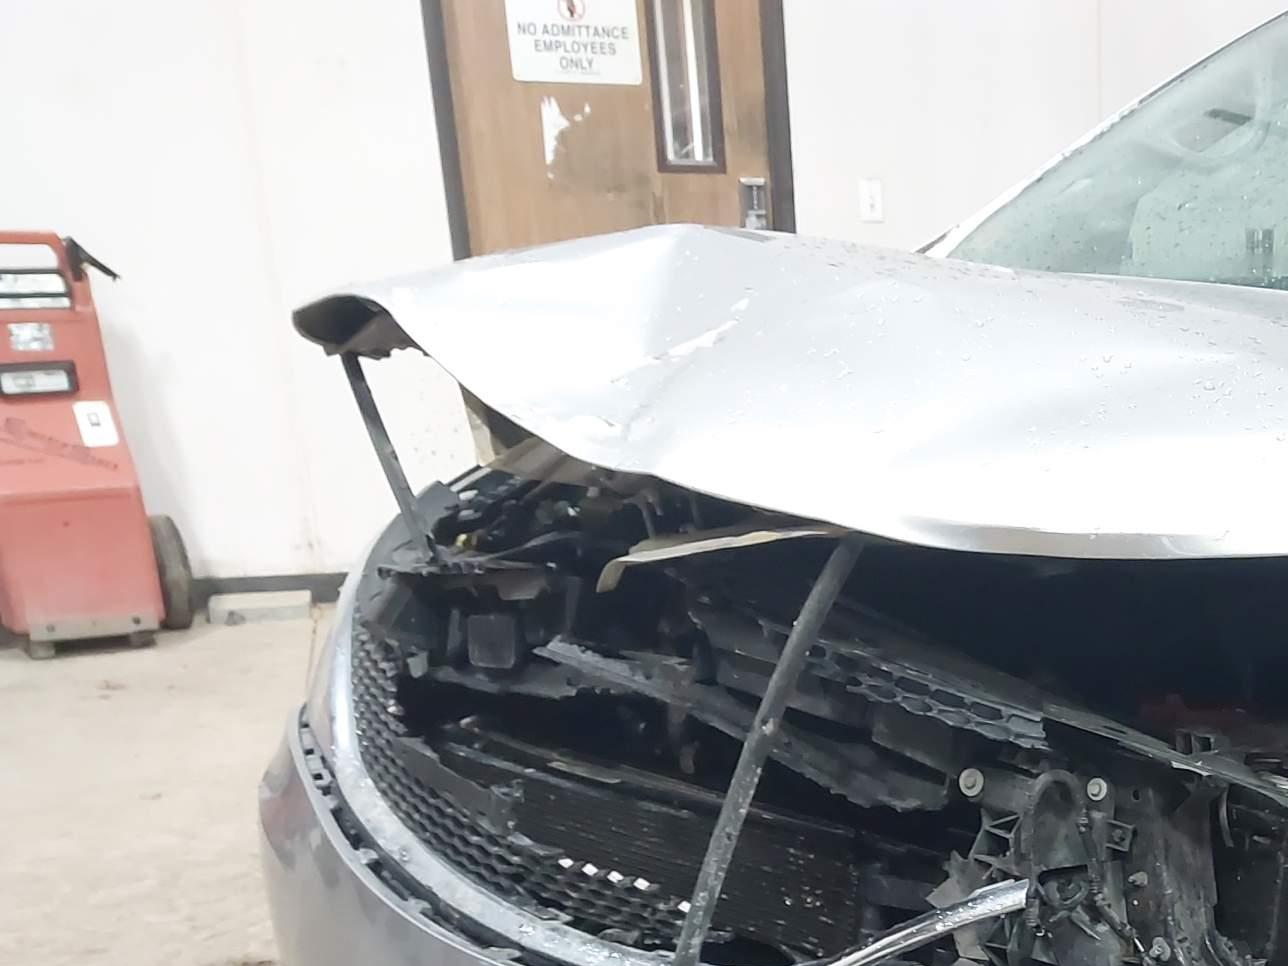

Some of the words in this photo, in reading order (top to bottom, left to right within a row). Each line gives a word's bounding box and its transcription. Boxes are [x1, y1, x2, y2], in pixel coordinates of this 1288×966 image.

[516, 22, 537, 36] NO
[542, 23, 630, 39] ADMITTANCE
[533, 39, 617, 55] EMPLOYEES
[558, 56, 594, 70] ONLY
